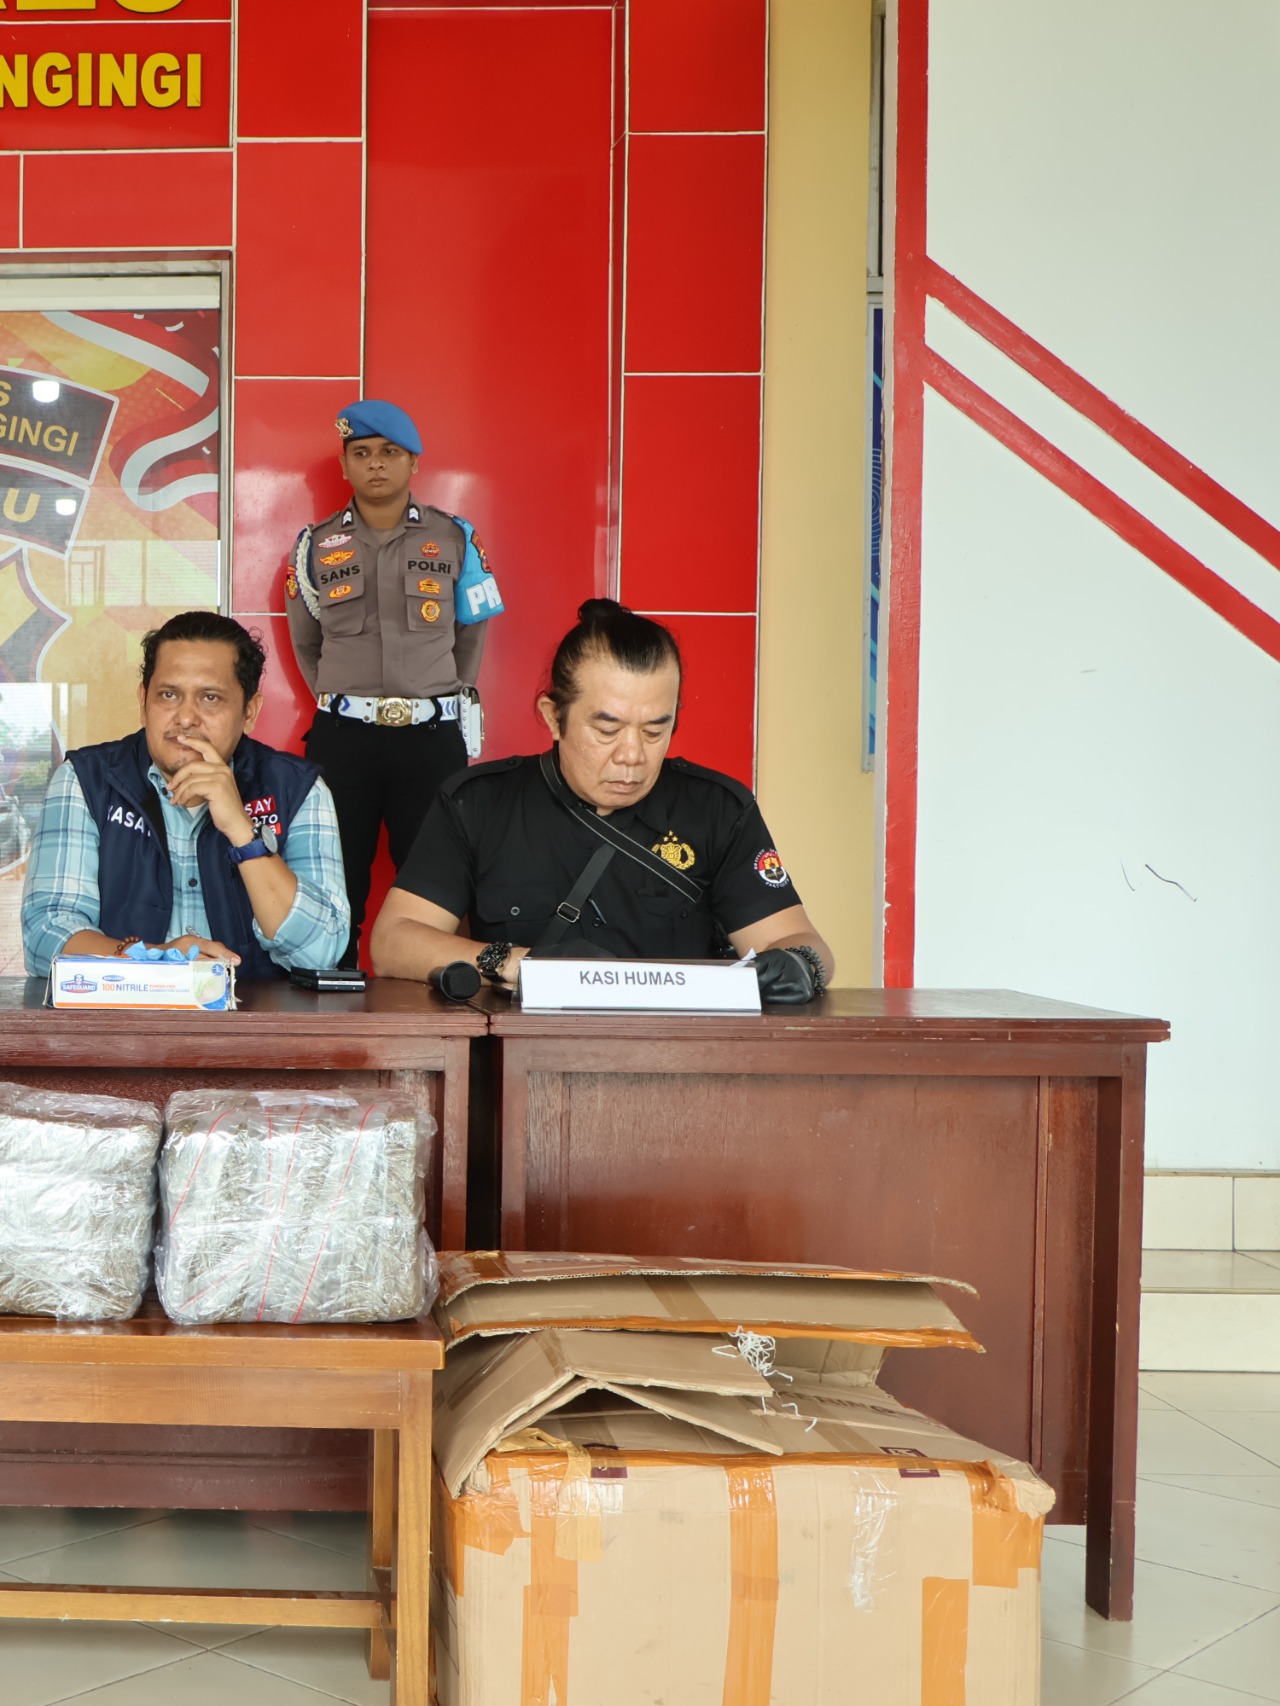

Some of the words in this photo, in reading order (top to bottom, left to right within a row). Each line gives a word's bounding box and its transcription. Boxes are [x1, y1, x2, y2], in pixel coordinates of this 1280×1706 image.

[320, 565, 361, 585] SANS
[407, 560, 452, 575] POLRI
[244, 797, 272, 816] SAY
[260, 813, 279, 825] TO
[578, 969, 620, 986] KASI
[624, 970, 686, 987] HUMAS
[102, 983, 115, 992] 100
[116, 983, 149, 992] NITRILE
